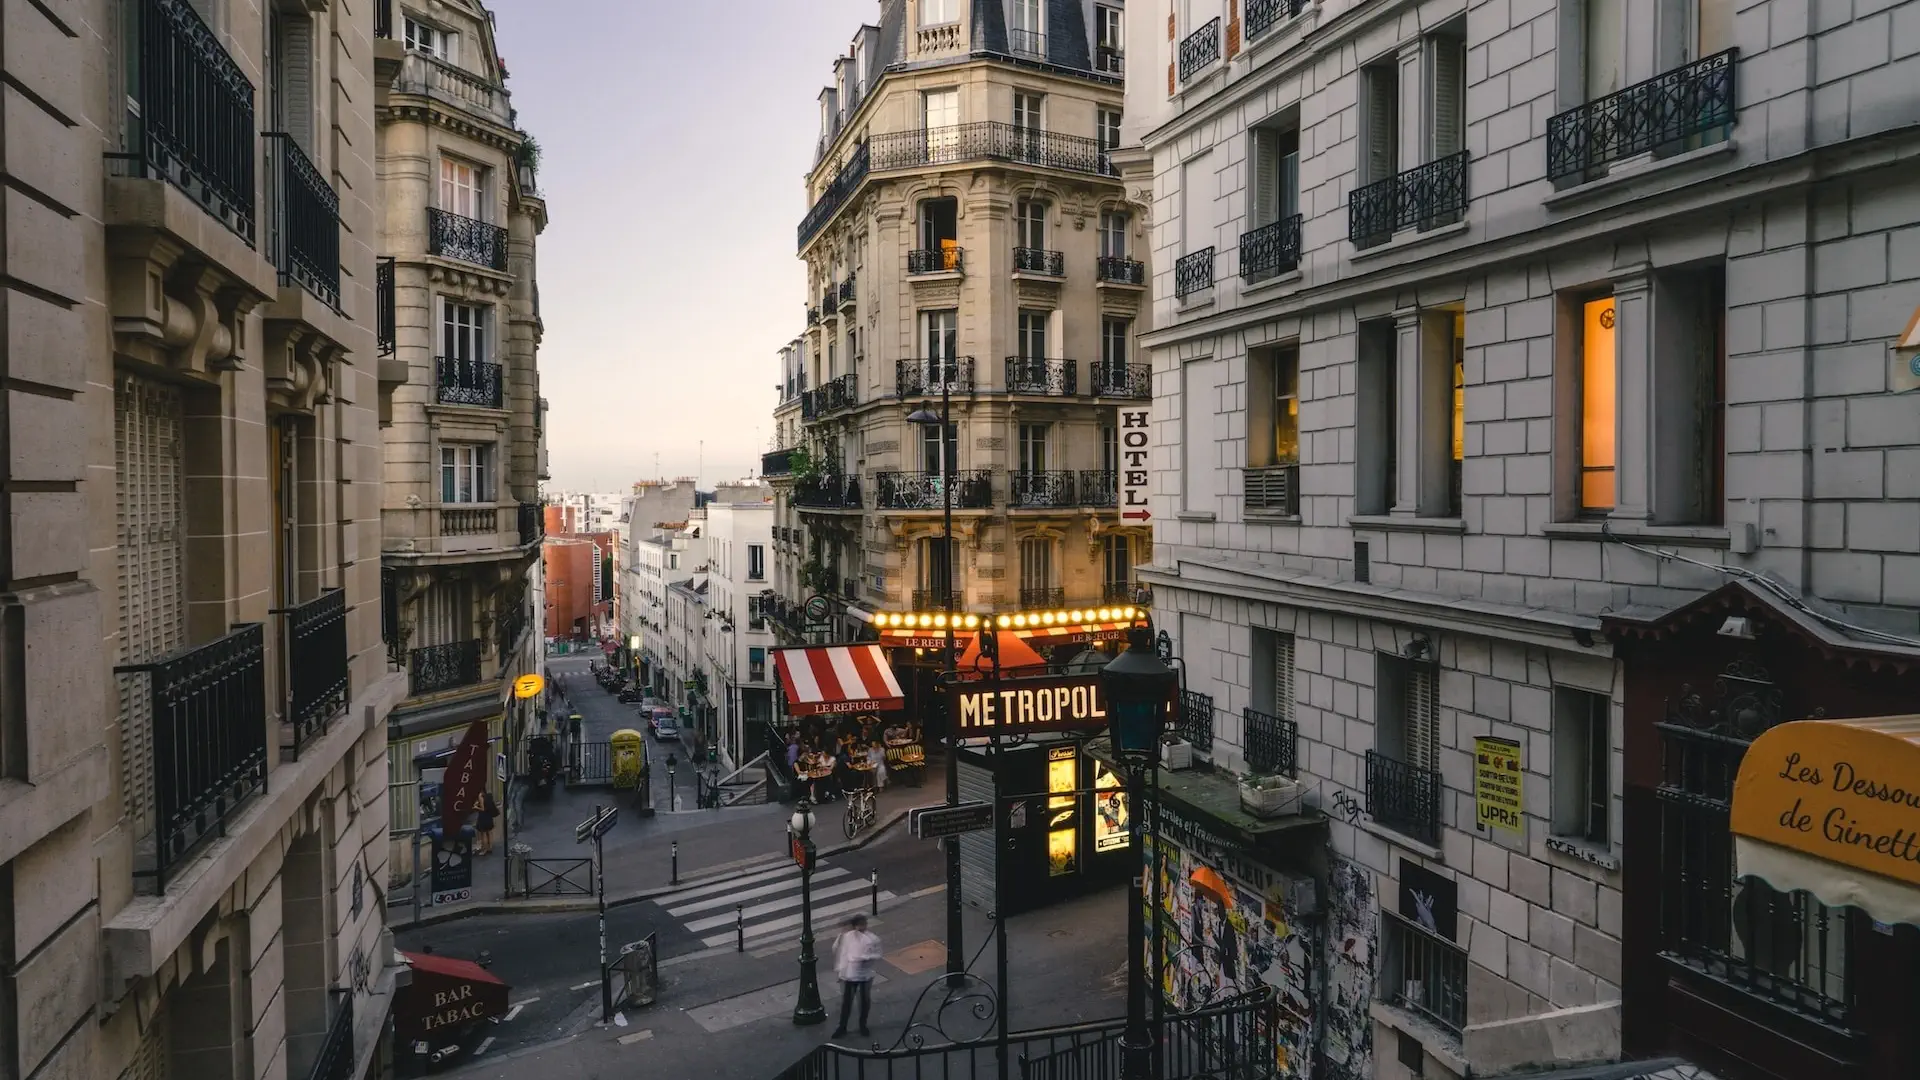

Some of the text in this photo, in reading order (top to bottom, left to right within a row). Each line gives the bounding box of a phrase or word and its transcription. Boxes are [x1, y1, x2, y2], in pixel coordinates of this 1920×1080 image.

[1122, 412, 1149, 505] HOTEL
[905, 638, 963, 648] LE REFUE
[1072, 634, 1084, 643] LE
[814, 701, 880, 714] LE REFUGE
[960, 685, 1172, 727] METROPOL
[453, 743, 478, 812] TABAC
[1779, 752, 1824, 785] Les
[1779, 798, 1813, 832] de
[434, 984, 473, 1009] BAR
[421, 1001, 484, 1032] TABAC
